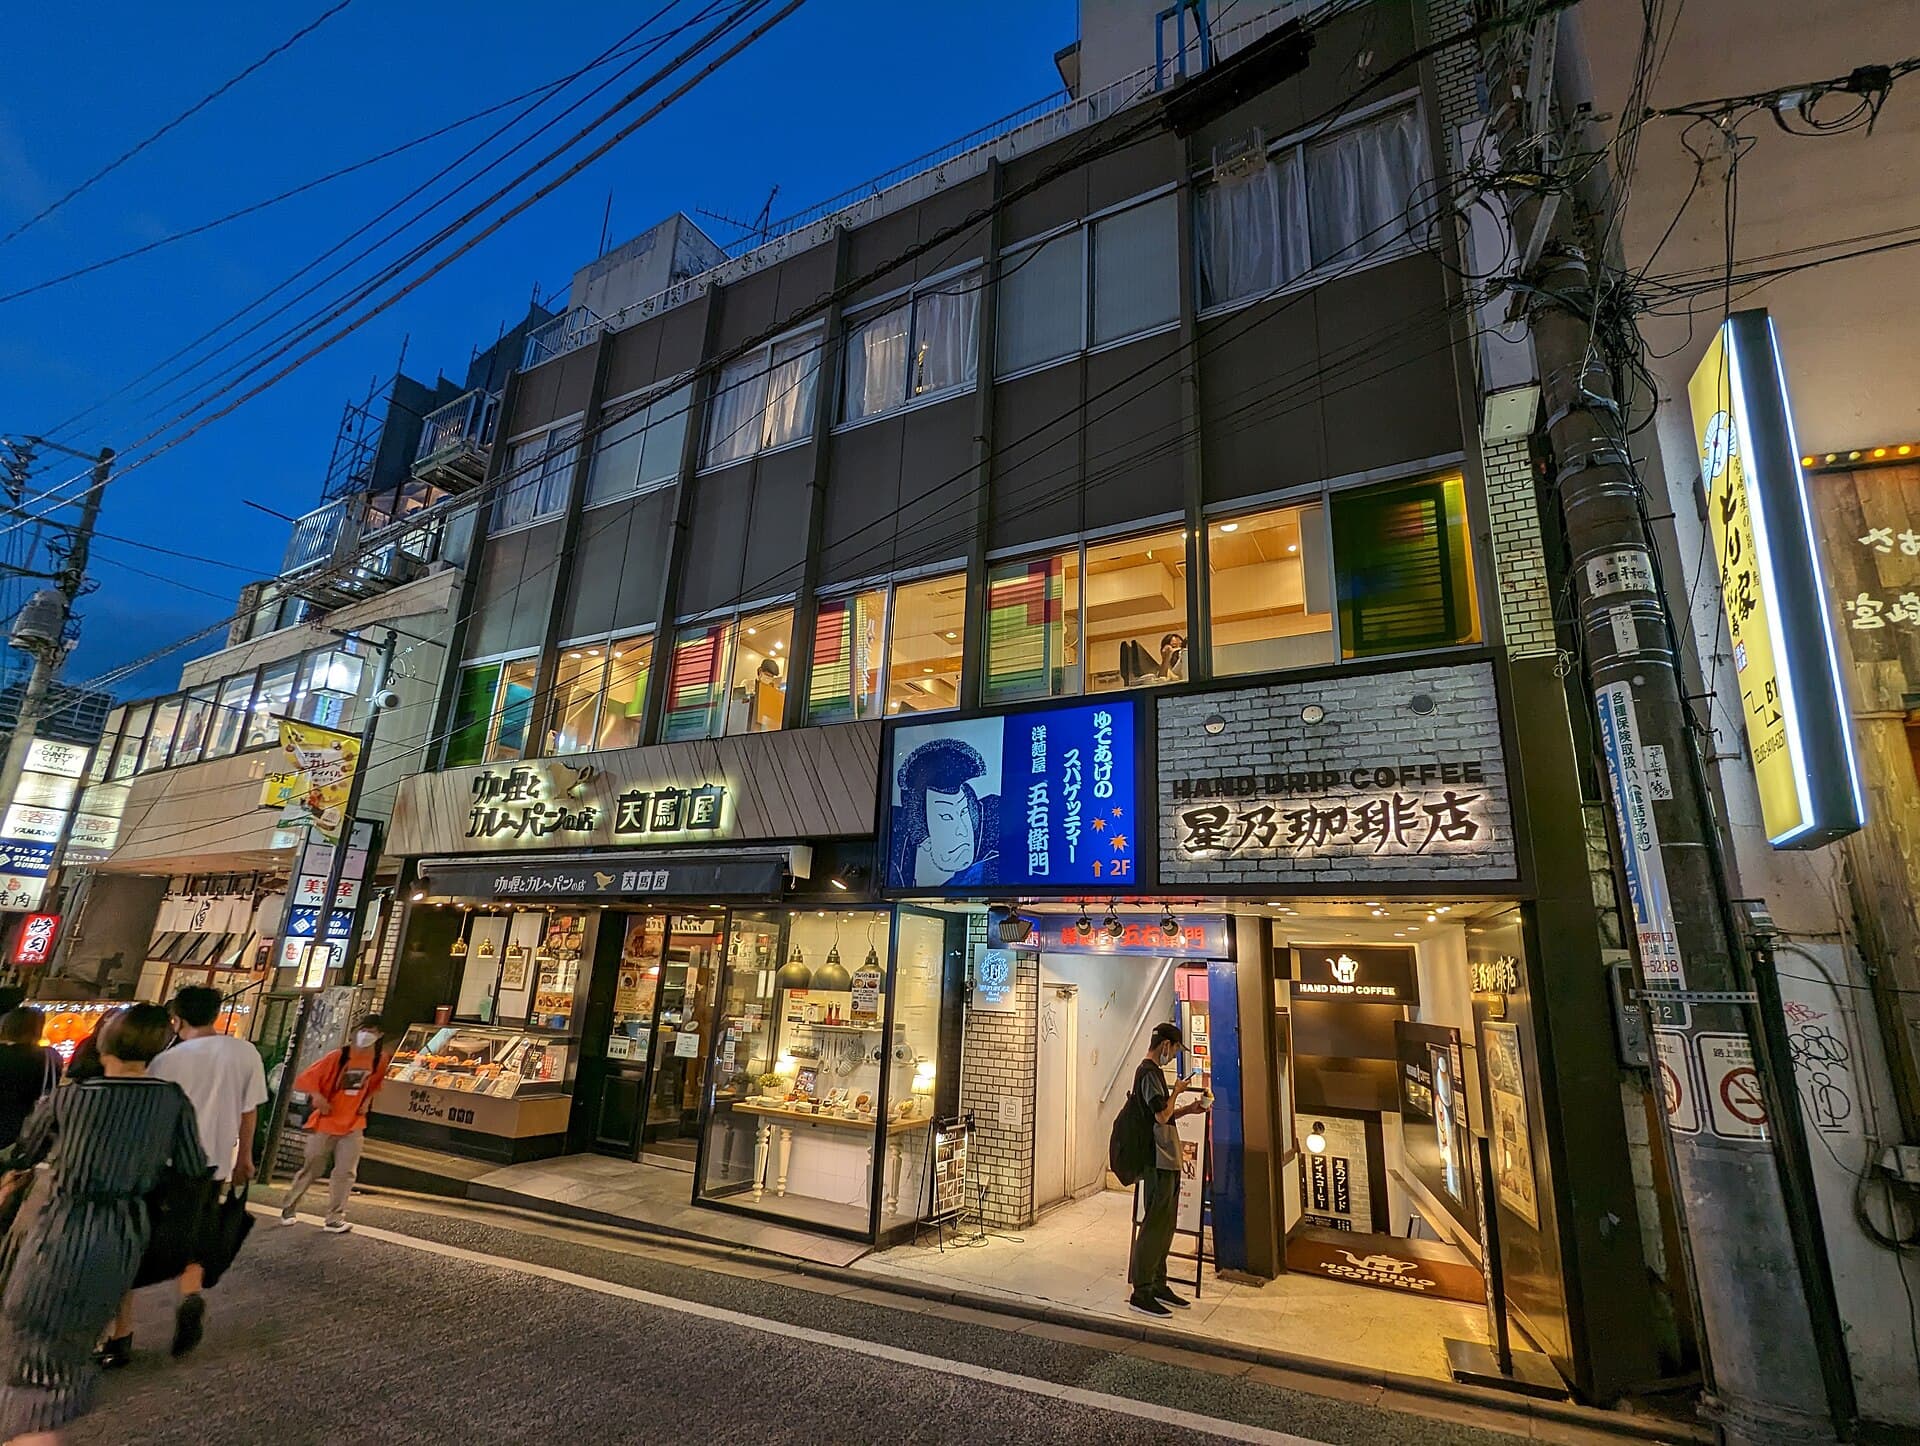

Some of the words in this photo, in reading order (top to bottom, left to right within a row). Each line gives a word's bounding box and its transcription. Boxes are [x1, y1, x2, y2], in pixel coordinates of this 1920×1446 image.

[1846, 592, 1920, 630] 宮崎
[1765, 675, 1779, 705] B1
[34, 748, 80, 760] COUNTRY
[42, 756, 69, 766] CITY
[43, 743, 71, 753] CITY
[1093, 710, 1114, 798] ゆであげの
[1173, 776, 1257, 800] HAND
[1265, 770, 1340, 795] DRIP
[1350, 761, 1484, 790] COFFEE
[465, 802, 598, 840] カレーパンの店
[614, 783, 726, 834] 天馬屋
[1063, 748, 1082, 864] スパゲッティー
[1026, 780, 1051, 877] 五右衛門
[1180, 790, 1482, 854] 星乃珈琲店
[620, 870, 670, 891] 天馬屋
[1110, 859, 1131, 876] 2F
[1300, 983, 1329, 993] HAND
[1329, 984, 1355, 994] DRIP
[1355, 986, 1396, 996] COFFEE
[1314, 1156, 1326, 1209] アイスコーヒー
[1320, 1262, 1436, 1286] HOSHINO
[1327, 1269, 1425, 1290] COFFEE
